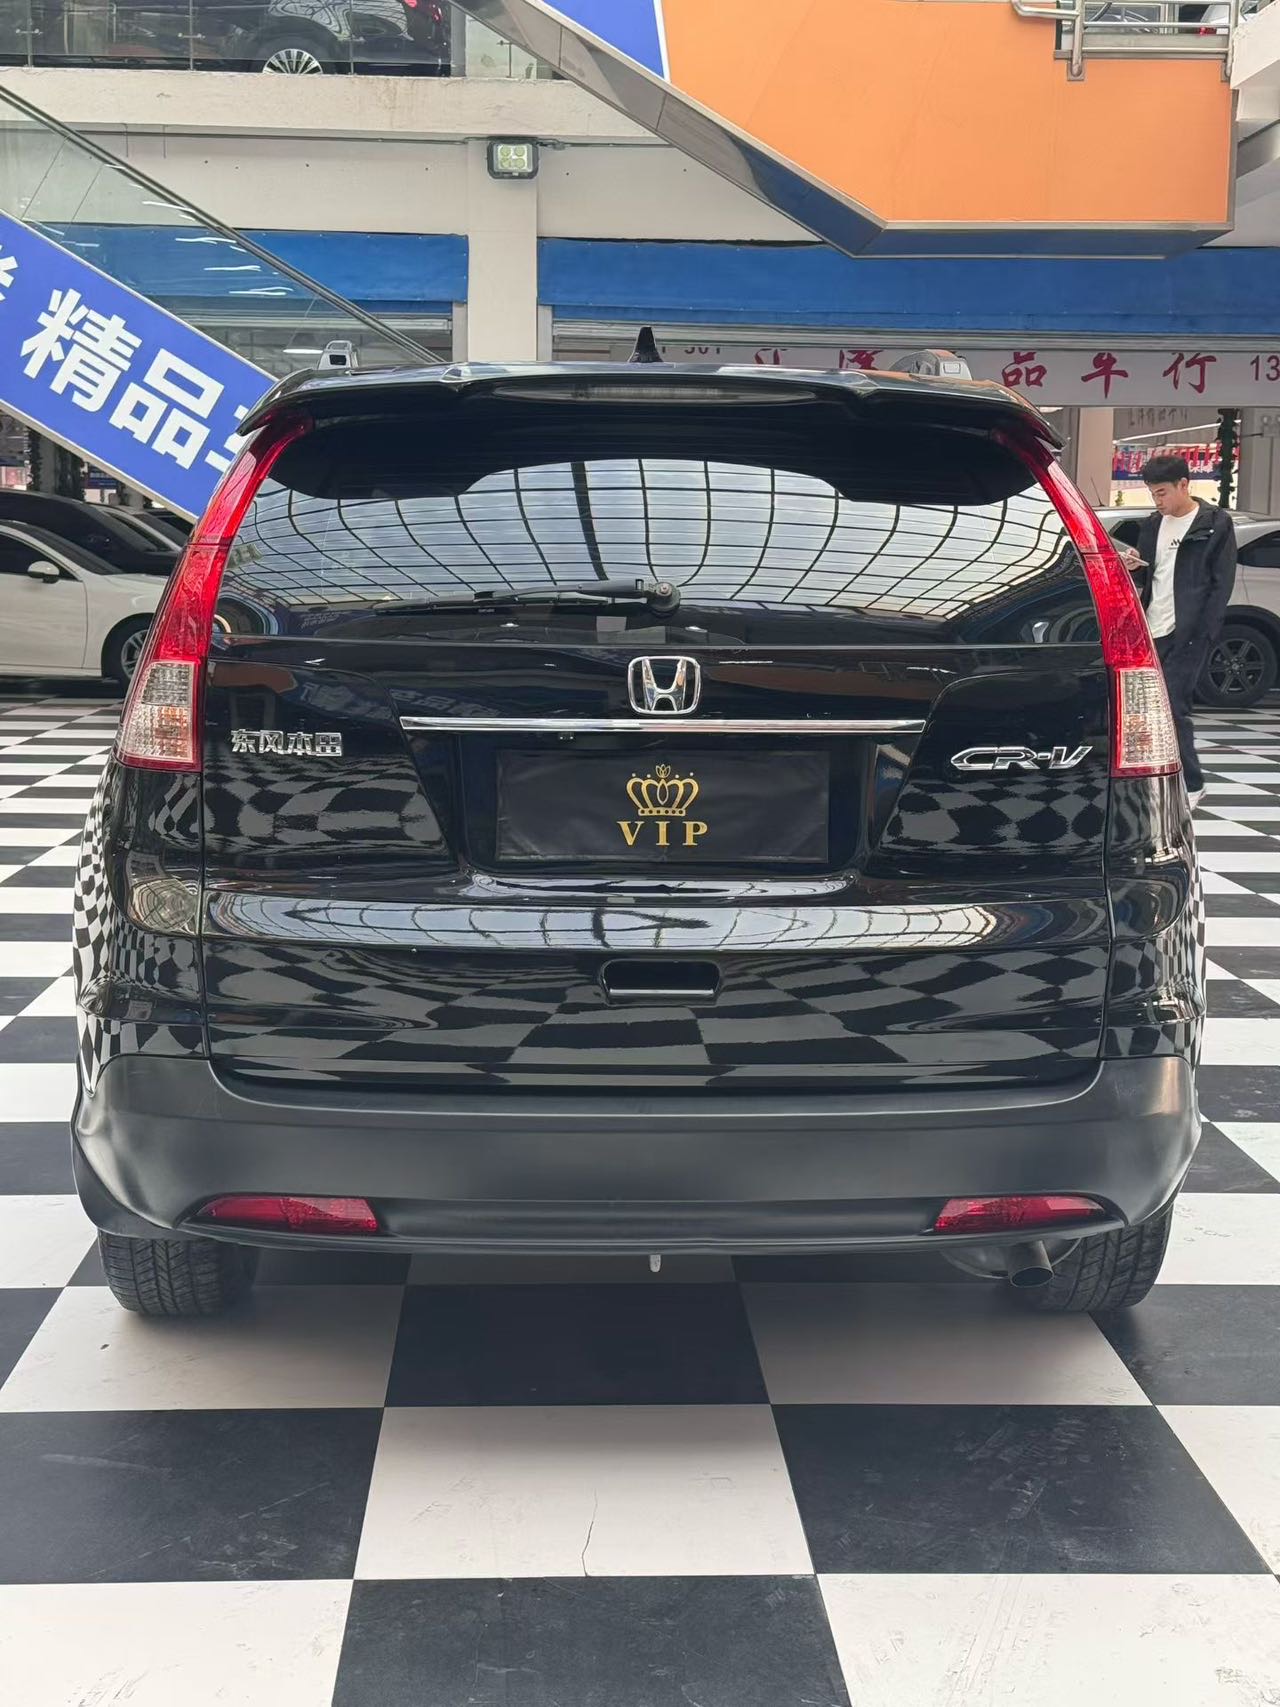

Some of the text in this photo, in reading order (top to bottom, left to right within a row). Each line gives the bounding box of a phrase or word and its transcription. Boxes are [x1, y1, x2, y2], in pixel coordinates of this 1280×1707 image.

[230, 728, 342, 757] 东风本田
[950, 745, 1094, 771] CR-V
[617, 820, 708, 846] VIP
